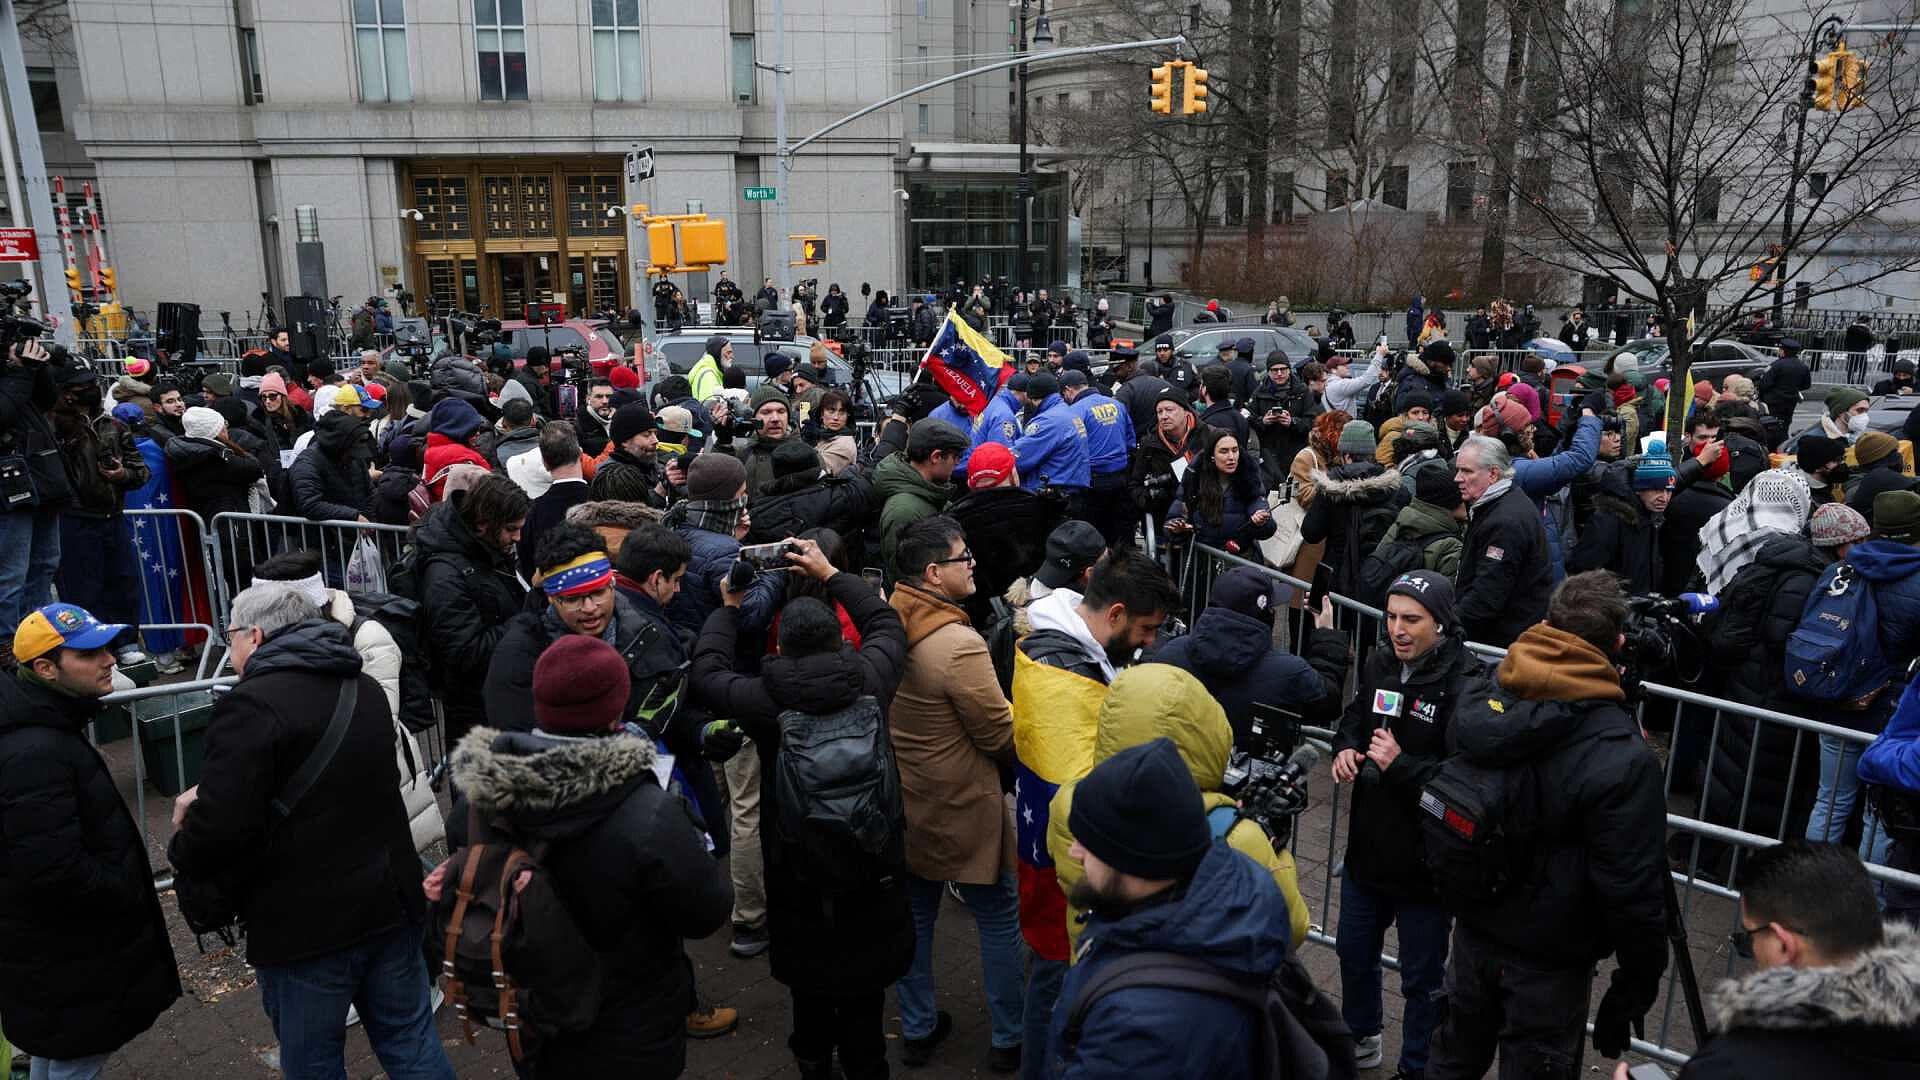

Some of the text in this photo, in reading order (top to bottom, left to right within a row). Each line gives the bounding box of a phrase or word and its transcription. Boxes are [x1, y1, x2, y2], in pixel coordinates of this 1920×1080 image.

[746, 189, 768, 198] Worth
[1091, 403, 1119, 420] NYPD
[1423, 703, 1436, 717] 41
